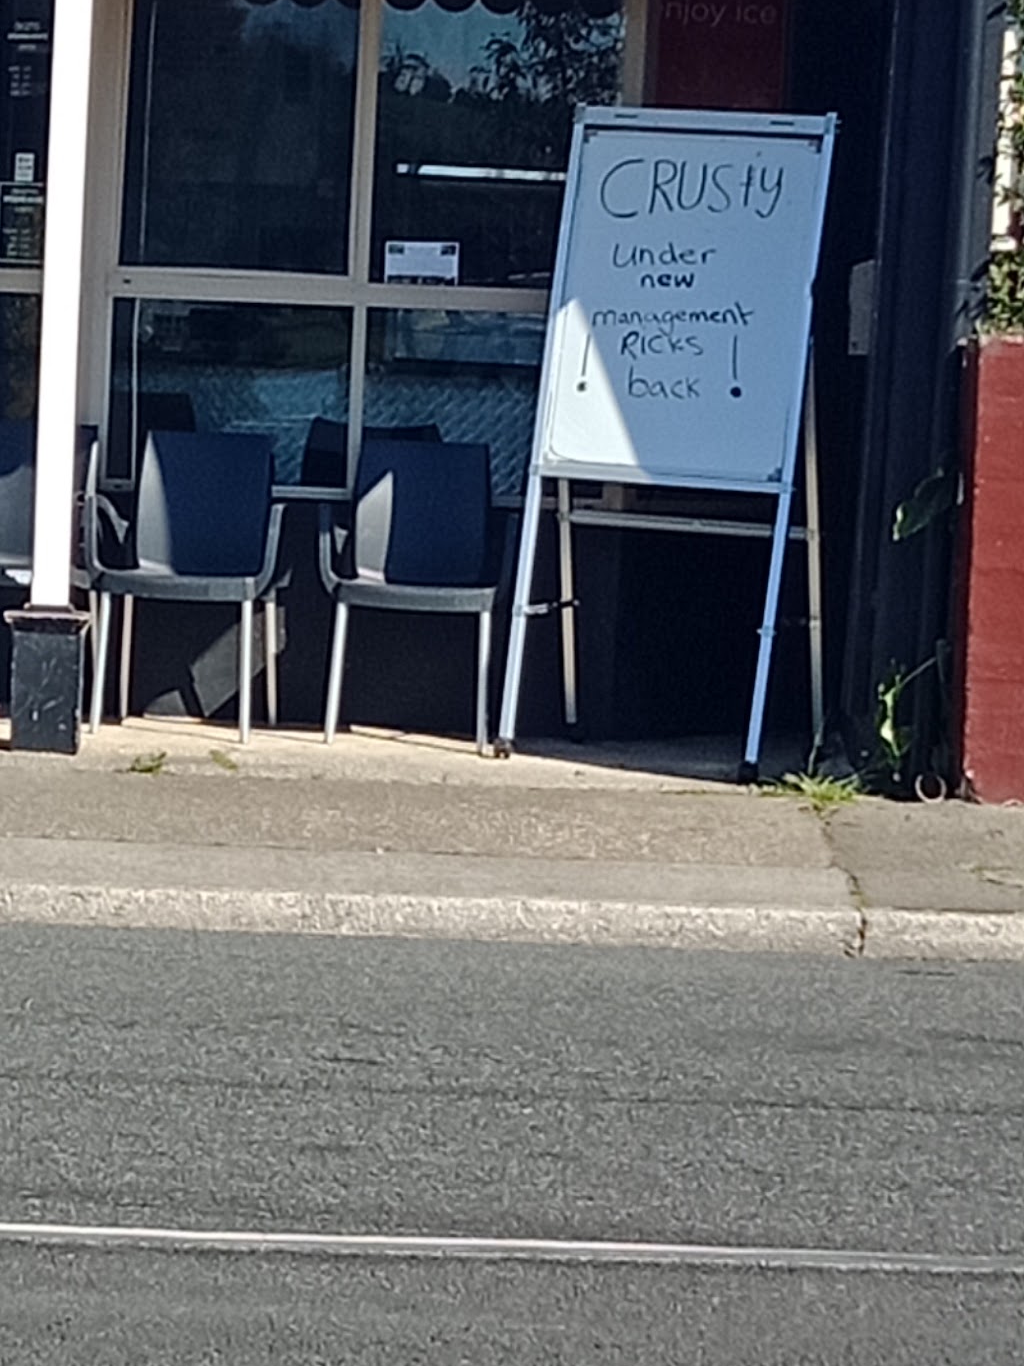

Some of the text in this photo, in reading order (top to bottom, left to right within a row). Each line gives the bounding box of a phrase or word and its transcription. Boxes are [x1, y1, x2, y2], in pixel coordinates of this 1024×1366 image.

[640, 271, 695, 288] new
[591, 301, 755, 334] management
[627, 365, 701, 400] back
